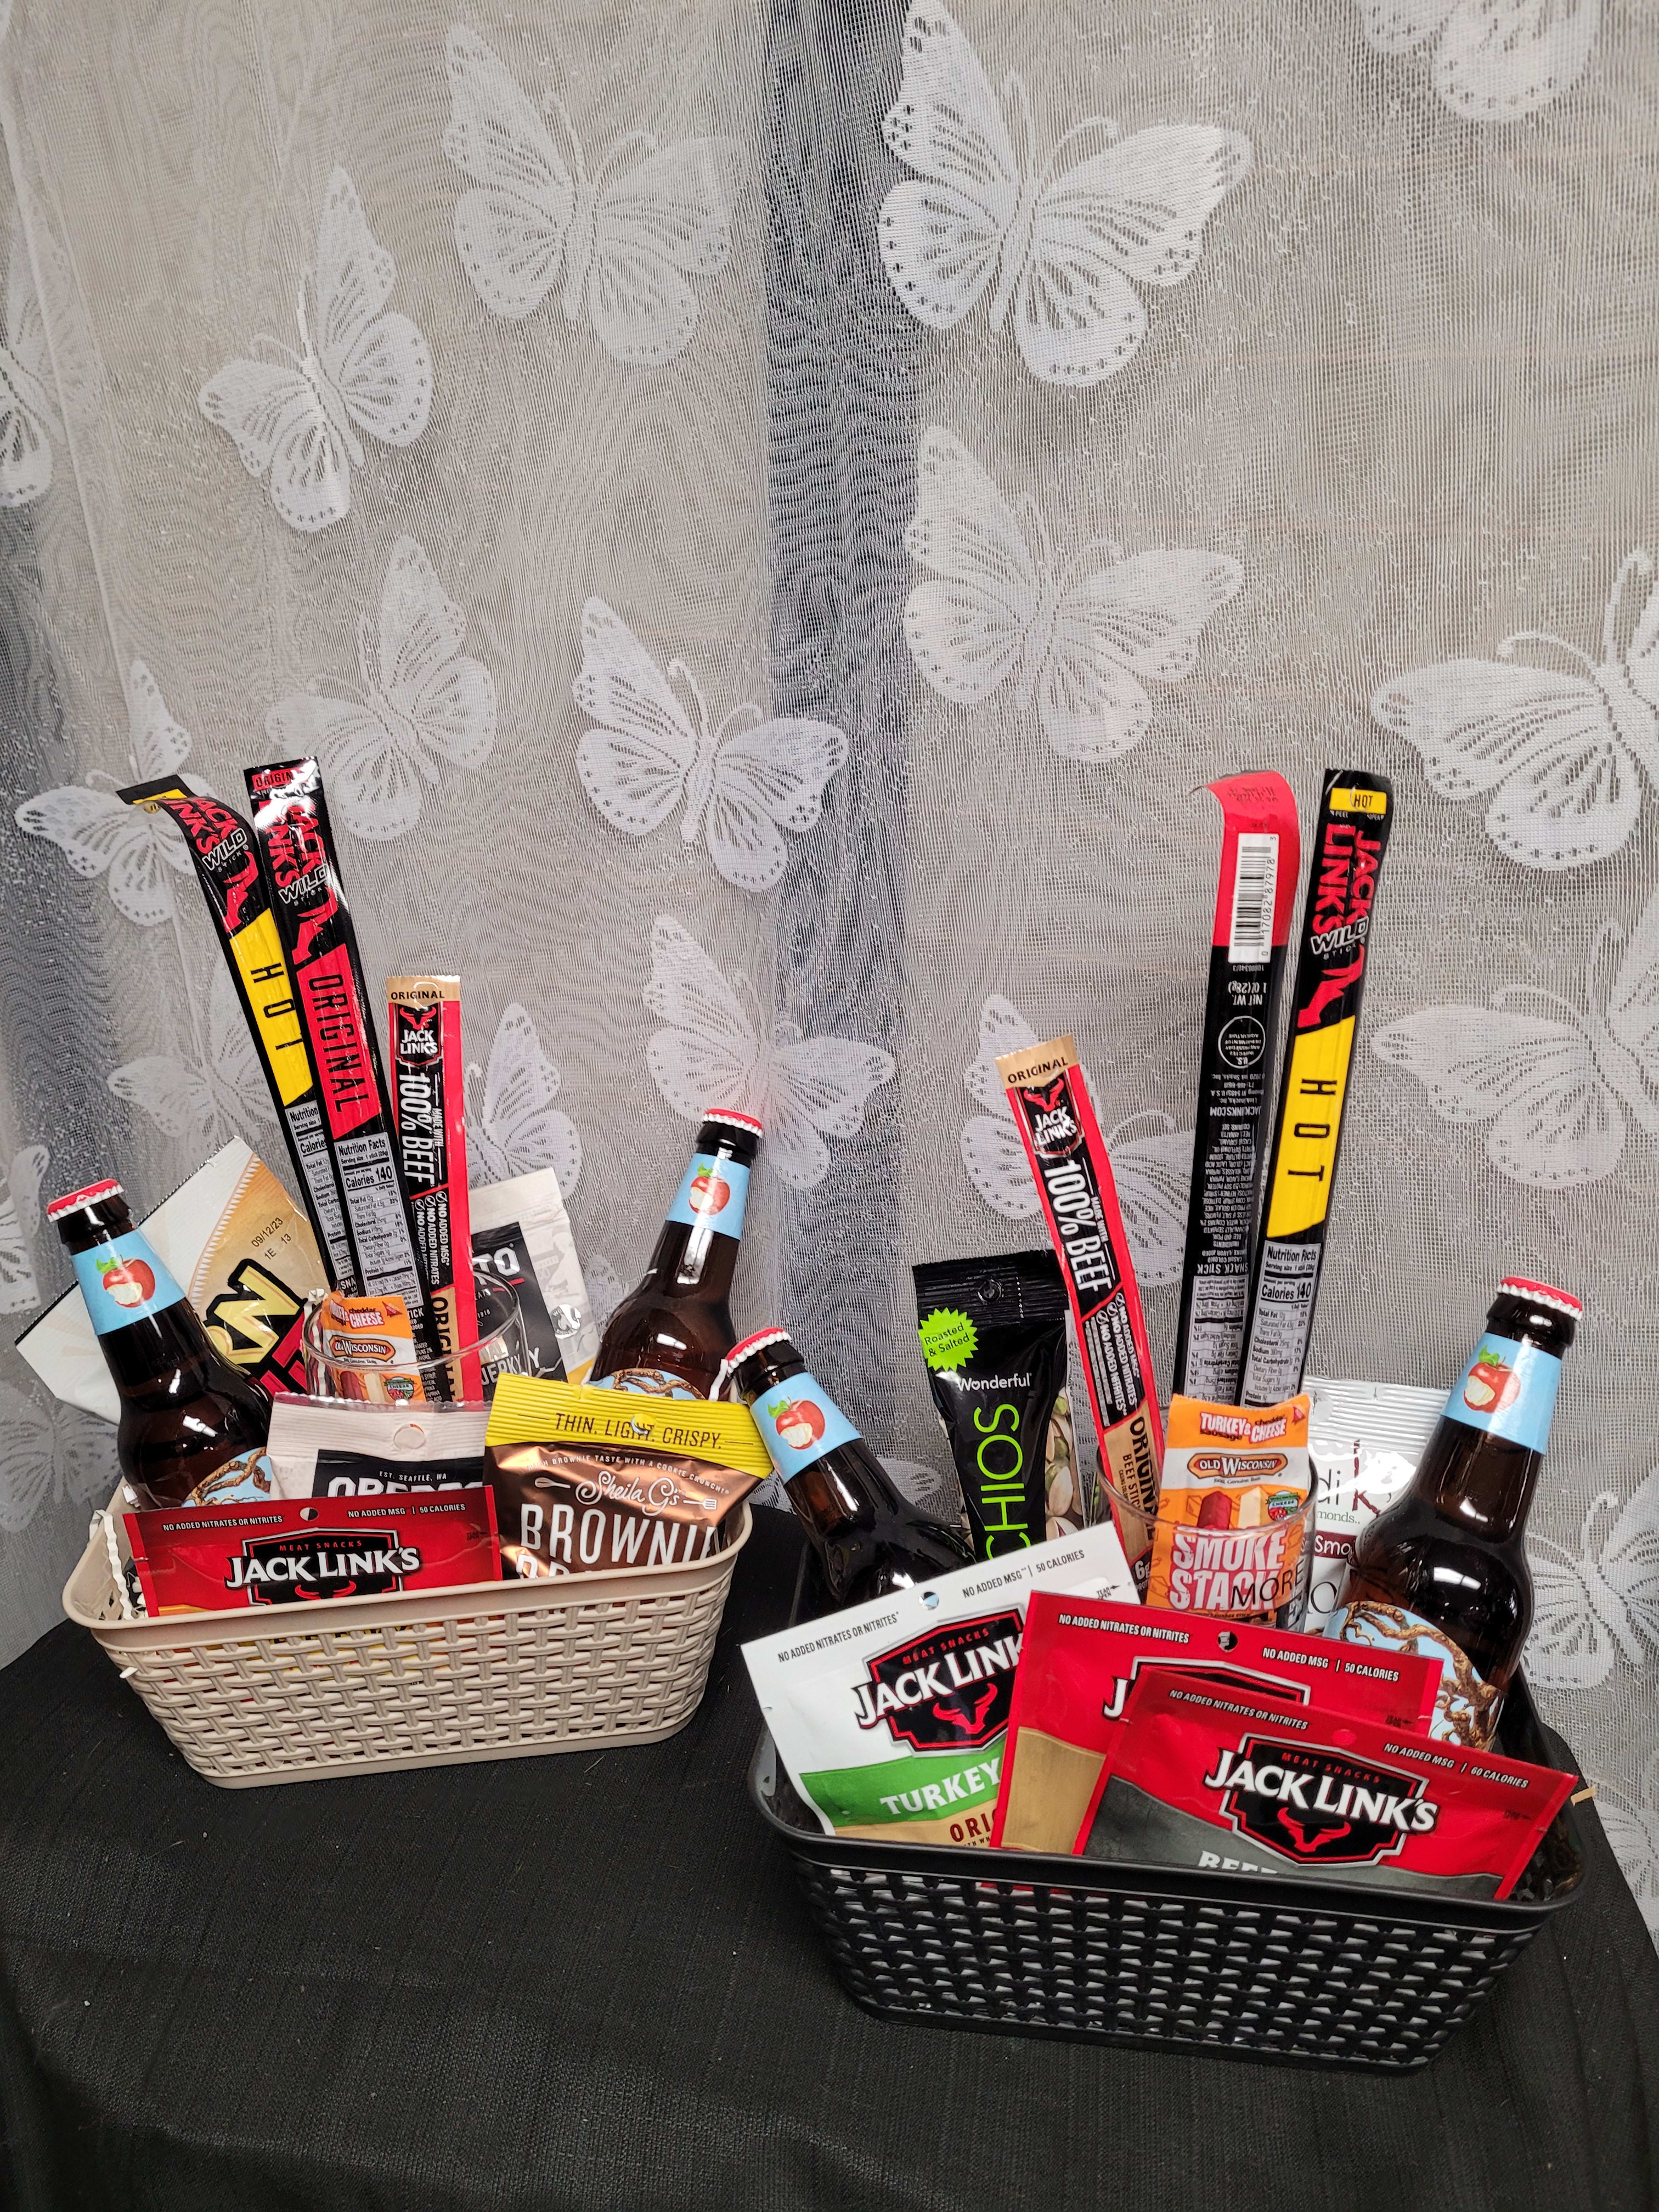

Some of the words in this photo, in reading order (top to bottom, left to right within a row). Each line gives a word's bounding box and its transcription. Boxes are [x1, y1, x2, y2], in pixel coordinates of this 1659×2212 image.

[1354, 794, 1374, 809] HOT
[202, 828, 248, 871] WILD
[278, 863, 331, 904] WILD
[1264, 858, 1276, 894] 87978
[1312, 822, 1356, 935] LINK'S
[1345, 830, 1381, 926] JACK
[1261, 900, 1273, 934] 17082
[1310, 916, 1369, 955] WILD
[391, 990, 445, 1000] ORIGINAL
[308, 974, 369, 1113] ORIGINAL
[401, 1029, 435, 1043] JACK
[1008, 1057, 1069, 1084] ORIGINAL
[290, 1105, 319, 1122] Nutrition
[399, 1072, 432, 1134] 100%
[294, 1122, 308, 1130] Serving
[1034, 1106, 1068, 1131] JACK
[1288, 1079, 1338, 1182] HOT
[338, 1143, 368, 1157] Nutrition
[368, 1138, 386, 1149] Facts
[434, 1130, 444, 1147] WITH
[341, 1156, 356, 1165] Serving
[402, 1136, 435, 1188] BEEF
[346, 1175, 375, 1188] Calories
[376, 1166, 392, 1181] 140
[1043, 1159, 1097, 1235] 100%
[416, 1211, 425, 1226] NO
[427, 1207, 436, 1222] NO
[438, 1203, 447, 1218] NO
[251, 1217, 284, 1248] 09/12/23
[427, 1222, 437, 1249] ADDED
[439, 1218, 448, 1244] ADDED
[264, 1248, 276, 1261] 1E
[280, 1233, 292, 1245] 13
[1267, 1245, 1300, 1262] Nutrition
[430, 1250, 440, 1285] NITRATES
[1065, 1234, 1113, 1292] BEEF
[1197, 1263, 1221, 1274] STICK
[1266, 1262, 1283, 1271] Serving
[1262, 1284, 1294, 1300] Calories
[1297, 1282, 1311, 1299] 140
[350, 1312, 384, 1328] CHEESE
[1119, 1306, 1128, 1324] NO
[1259, 1308, 1269, 1317] Total
[923, 1322, 964, 1346] Roasted
[1099, 1324, 1111, 1342] NO
[1111, 1316, 1121, 1334] NO
[342, 1339, 386, 1356] WISCONSIN
[928, 1348, 936, 1357] &
[938, 1333, 970, 1353] Salted
[1114, 1334, 1128, 1364] ADDED
[1122, 1324, 1135, 1355] ADDED
[1253, 1346, 1269, 1355] Sodium
[1103, 1342, 1118, 1373] ADDED
[957, 1373, 1031, 1392] Wonderful
[1245, 1391, 1262, 1400] Protein
[556, 1413, 597, 1435] THIN.
[662, 1426, 722, 1449] CRISPY.
[1200, 1412, 1248, 1436] TURKEY
[1244, 1423, 1251, 1436] &
[1251, 1418, 1287, 1442] CHEESE
[1200, 1430, 1243, 1441] sausage
[379, 1471, 395, 1480] EST.
[552, 1455, 591, 1465] BROWNIE
[594, 1455, 621, 1464] TASTE
[624, 1457, 646, 1466] WITH
[657, 1462, 686, 1477] COOKIE
[1123, 1453, 1136, 1480] BEEF
[1199, 1459, 1221, 1470] OLD
[1220, 1457, 1278, 1476] WISCONSIN
[575, 1471, 646, 1505] Sheila
[361, 1509, 387, 1517] ADDED
[388, 1508, 405, 1516] MSG
[419, 1506, 428, 1514] 50
[430, 1504, 466, 1513] CALORIES
[1317, 1510, 1361, 1525] monds..
[176, 1521, 201, 1530] ADDED
[201, 1519, 238, 1528] NITRATES
[239, 1518, 249, 1526] OR
[250, 1515, 283, 1525] NITRITES
[279, 1543, 309, 1552] MEAT
[316, 1540, 363, 1549] SNACKS
[1173, 1528, 1287, 1571] SMOKE
[226, 1556, 318, 1588] JACK
[317, 1547, 420, 1578] LINK'S
[1036, 1562, 1046, 1573] 50
[1046, 1550, 1085, 1570] CALORIES
[962, 1587, 975, 1598] NO
[976, 1576, 1003, 1594] ADDED
[1170, 1568, 1279, 1611] STACK
[1231, 1559, 1304, 1609] MORE
[1059, 1613, 1071, 1625] NO
[1072, 1616, 1099, 1629] ADDED
[1100, 1620, 1139, 1635] NITRATES
[1141, 1626, 1152, 1637] OR
[1153, 1628, 1189, 1644] NITRITES
[778, 1651, 789, 1663] NO
[791, 1641, 816, 1658] ADDED
[816, 1629, 851, 1649] NITRATES
[853, 1626, 862, 1637] OR
[902, 1646, 935, 1665] MEAT
[940, 1627, 989, 1651] SNACKS
[1262, 1647, 1276, 1659] NO
[1276, 1651, 1306, 1664] ADDED
[1308, 1655, 1329, 1668] MSG
[852, 1661, 954, 1728] JACK
[944, 1633, 1023, 1688] LINK
[1345, 1662, 1355, 1673] 50
[1356, 1665, 1400, 1682] CALORIES
[1169, 1689, 1183, 1699] NO
[1183, 1694, 1213, 1707] ADDED
[1213, 1700, 1256, 1717] NITRATES
[1256, 1710, 1267, 1720] OR
[1268, 1713, 1308, 1730] NITRITES
[1280, 1752, 1318, 1768] MEAT
[1324, 1763, 1381, 1784] SNACKS
[1384, 1743, 1400, 1754] NO
[1399, 1747, 1432, 1763] ADDED
[1432, 1756, 1455, 1769] MSG
[880, 1757, 1000, 1815] TURKEY
[1204, 1748, 1315, 1809] JACK
[1312, 1774, 1438, 1832] LINK'S
[1471, 1767, 1483, 1777] 60
[1483, 1770, 1530, 1789] CALORIES
